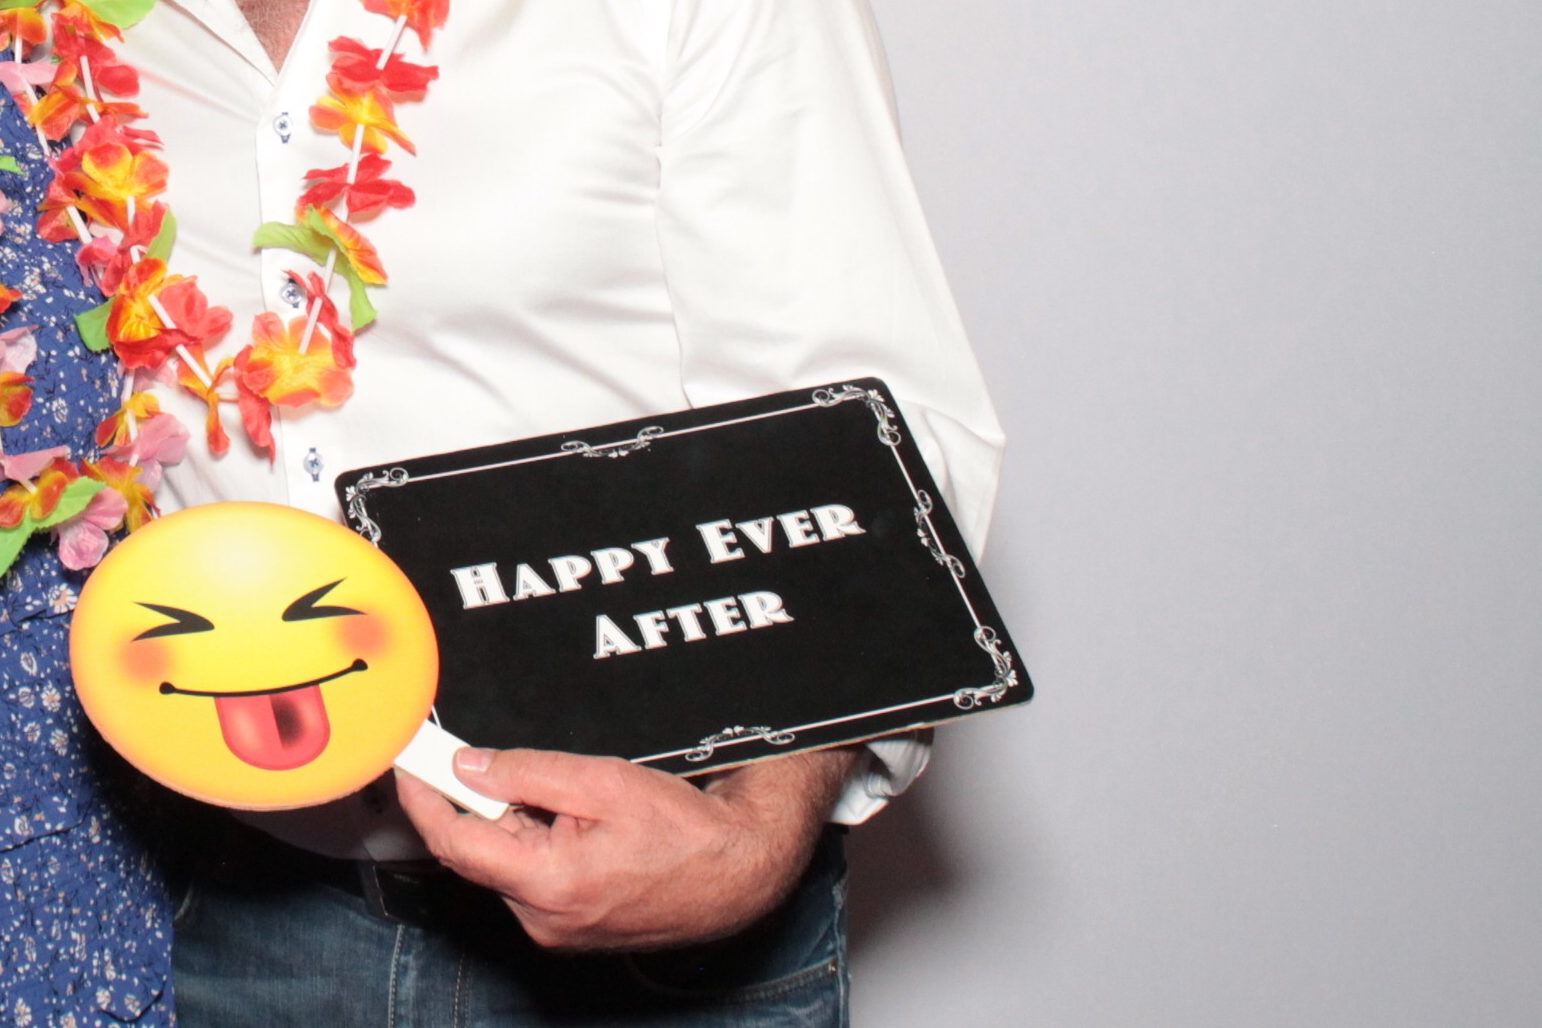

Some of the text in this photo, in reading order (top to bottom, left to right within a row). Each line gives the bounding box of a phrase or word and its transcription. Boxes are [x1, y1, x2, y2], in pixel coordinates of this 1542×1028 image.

[449, 504, 866, 610] HAPPY EVER
[593, 591, 796, 660] AFTER
